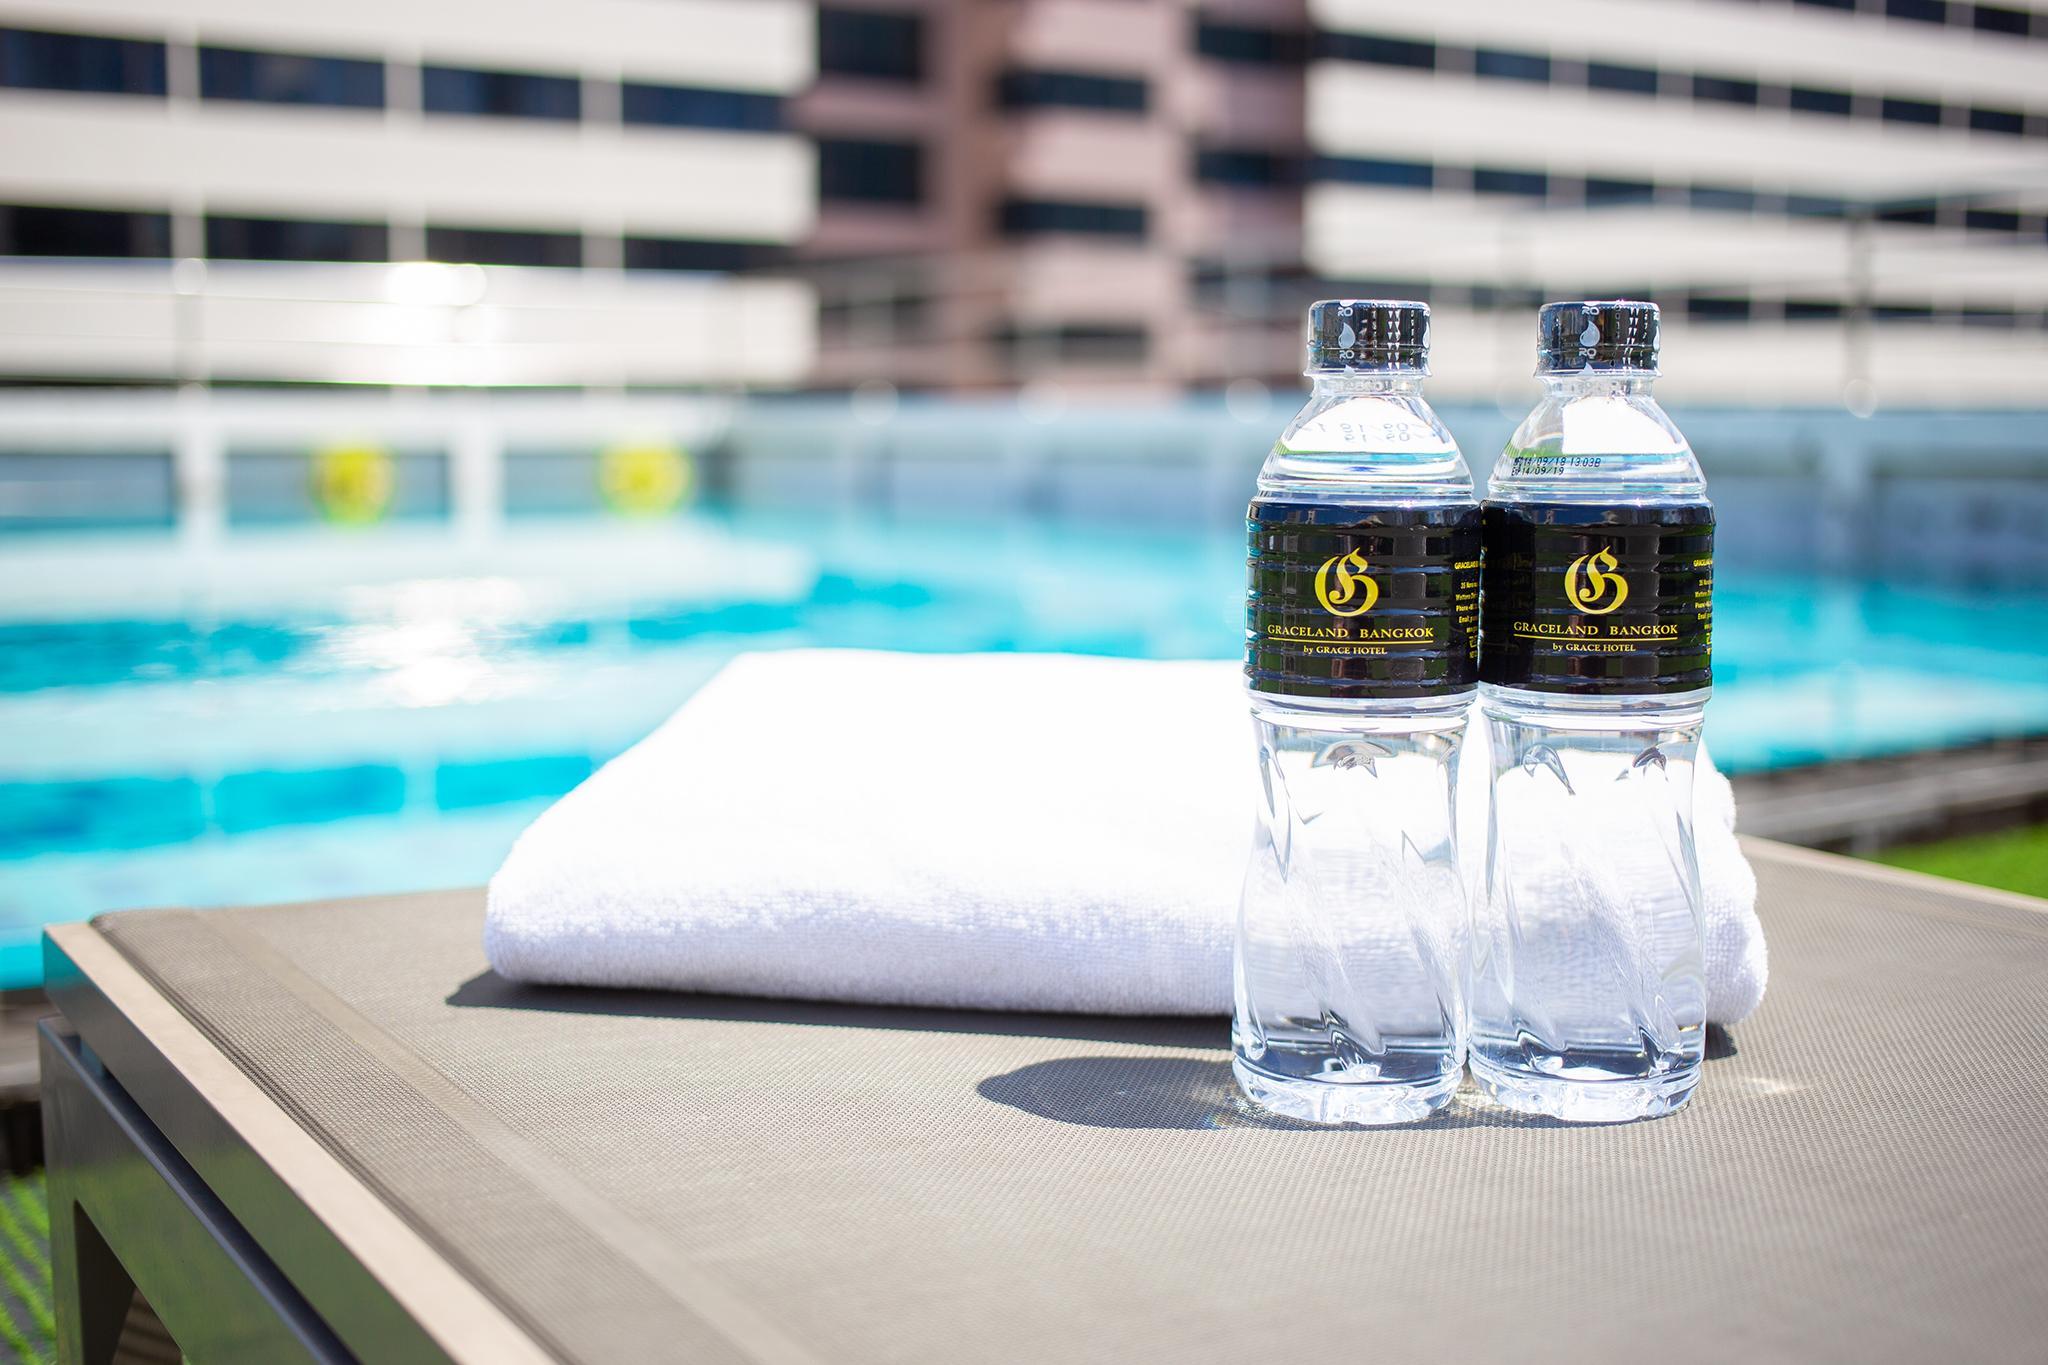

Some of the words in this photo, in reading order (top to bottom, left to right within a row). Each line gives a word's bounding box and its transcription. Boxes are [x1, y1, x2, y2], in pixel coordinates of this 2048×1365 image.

[1267, 624, 1349, 639] GRACELAND
[1360, 627, 1434, 639] BANGKOK
[1513, 621, 1599, 636] GRACELAND
[1609, 624, 1678, 636] BANGKOK
[1303, 645, 1314, 655] by
[1316, 646, 1350, 654] GRACE
[1353, 646, 1388, 655] HOTEL
[1552, 642, 1563, 652] by
[1565, 643, 1600, 652] GRACE
[1603, 643, 1636, 652] HOTEL
